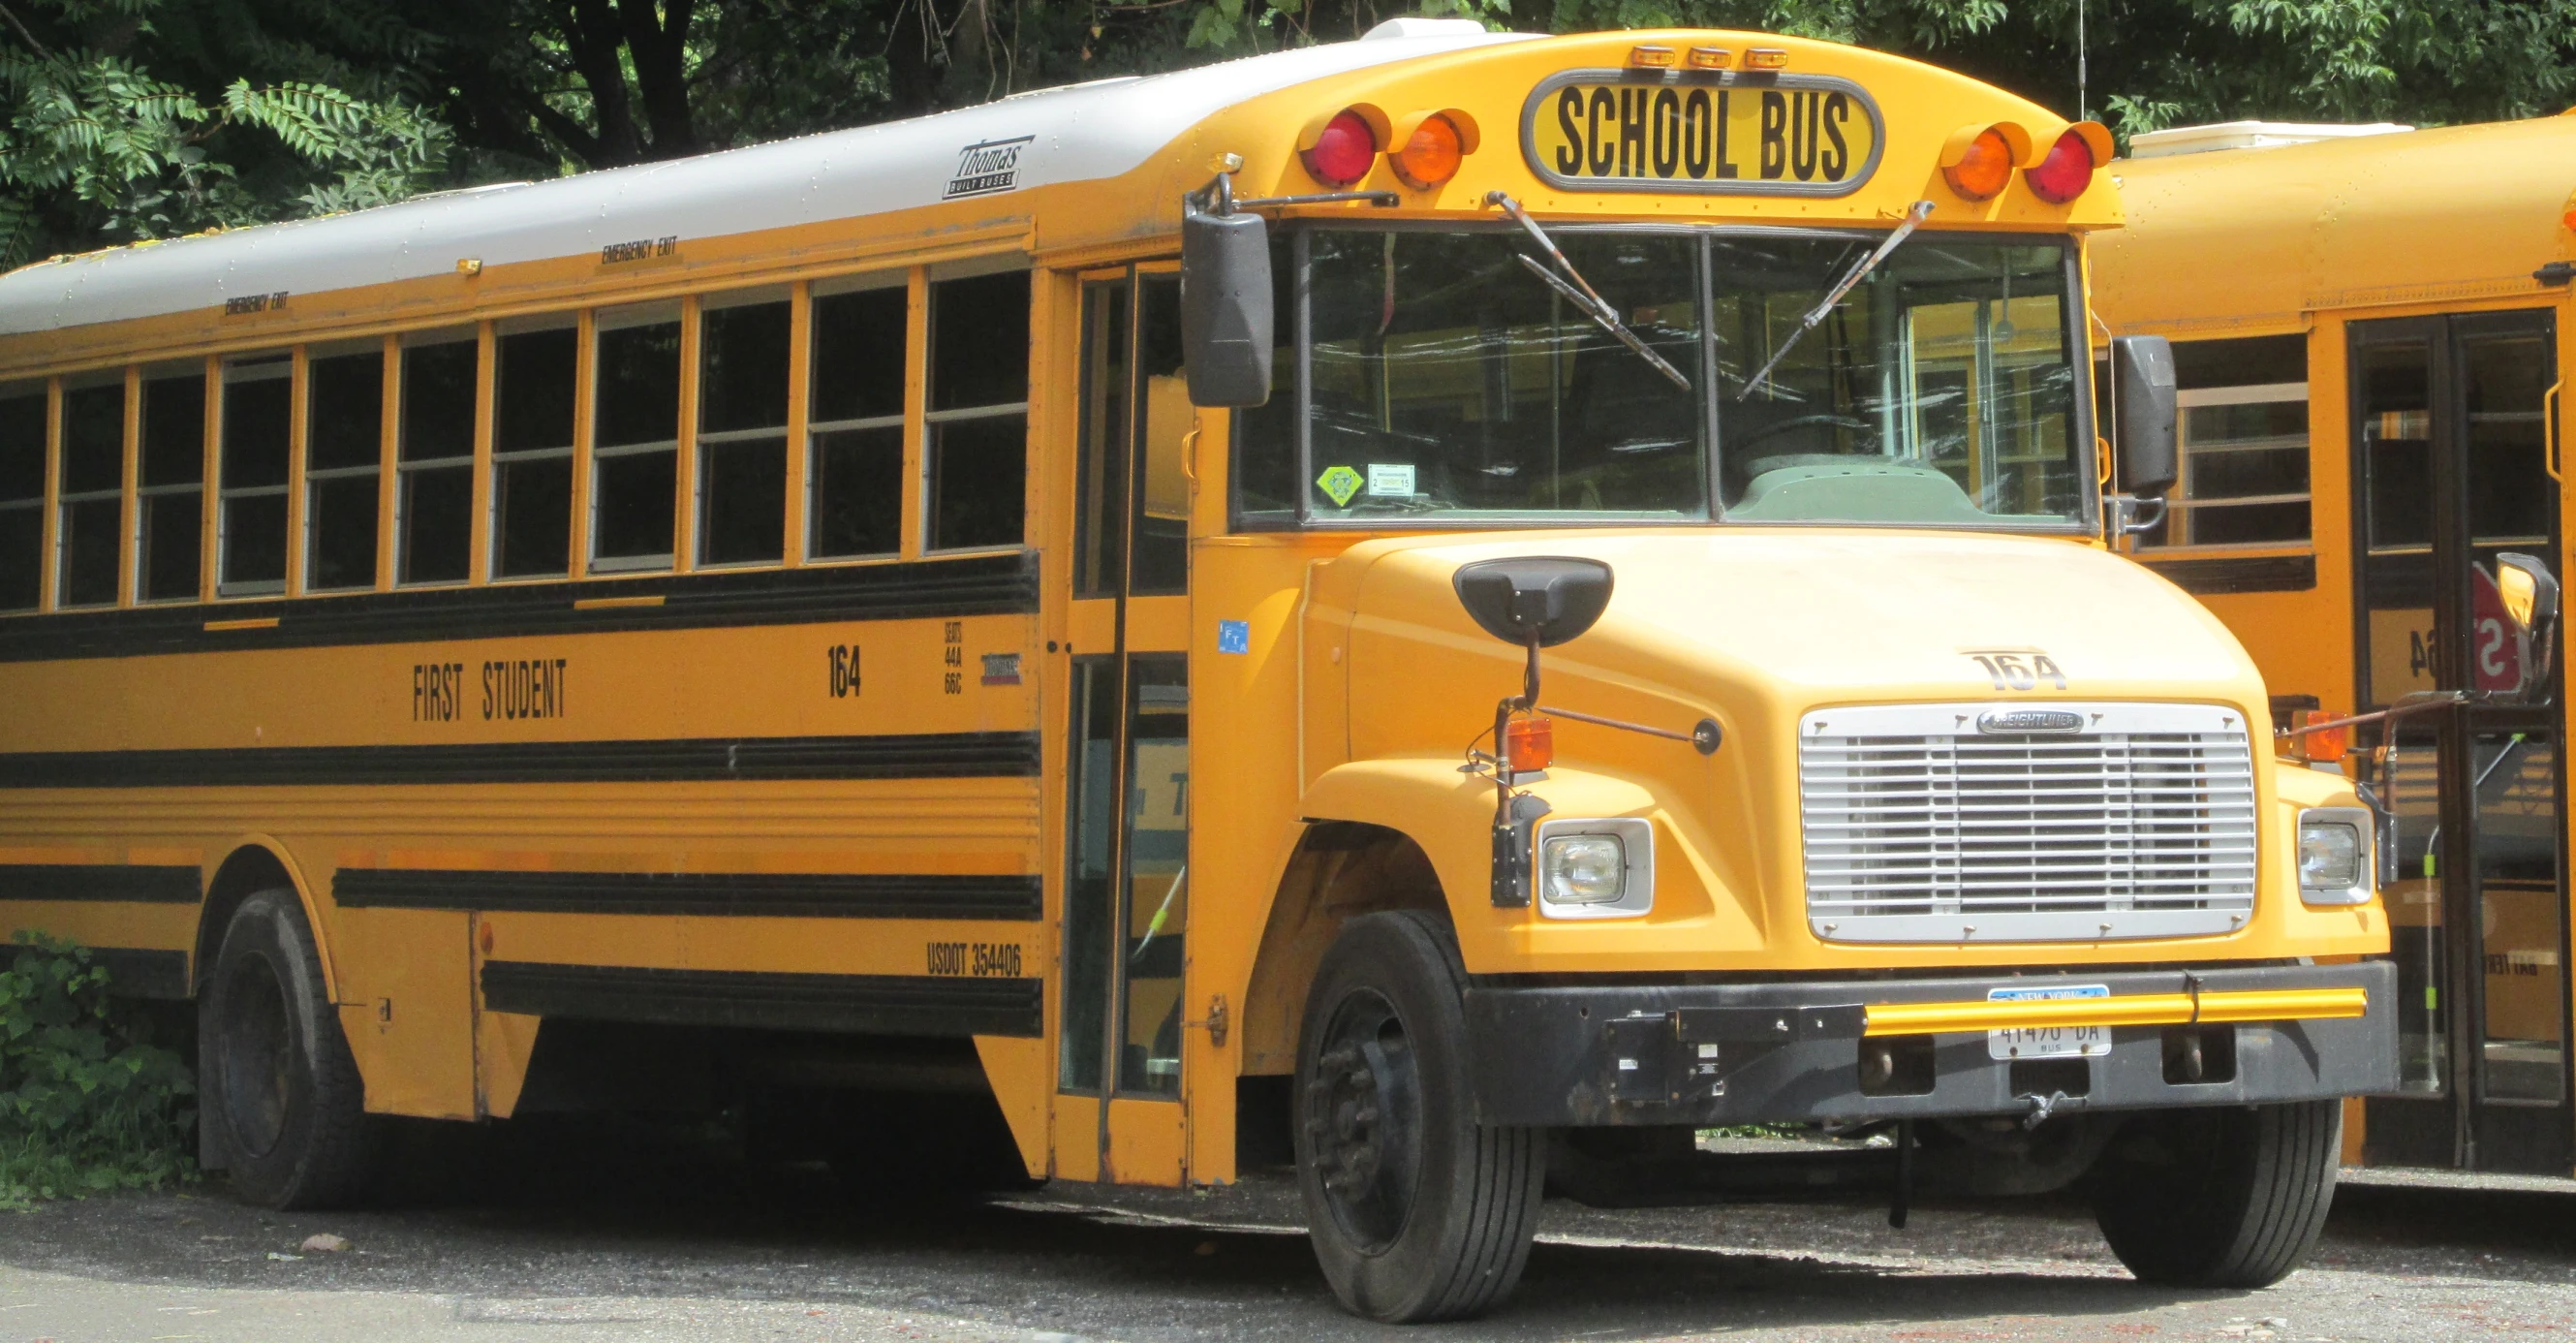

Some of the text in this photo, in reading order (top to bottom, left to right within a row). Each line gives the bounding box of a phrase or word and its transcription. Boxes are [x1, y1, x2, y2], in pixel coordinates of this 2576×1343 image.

[1557, 86, 1849, 182] SCHOOL BUS
[956, 135, 1036, 177] Thomas
[949, 173, 1012, 193] BUILT BUSES
[602, 235, 677, 265] EMERGENCY EXIT
[225, 291, 290, 316] EMERGENCY EXIT
[945, 622, 962, 643] SEATS
[827, 644, 861, 698] 164
[945, 646, 962, 668] 44A
[1971, 655, 2067, 691] 164
[414, 659, 567, 722] FIRST STUDENT
[945, 672, 962, 695] 66C
[927, 942, 1021, 977] USDOT 354406
